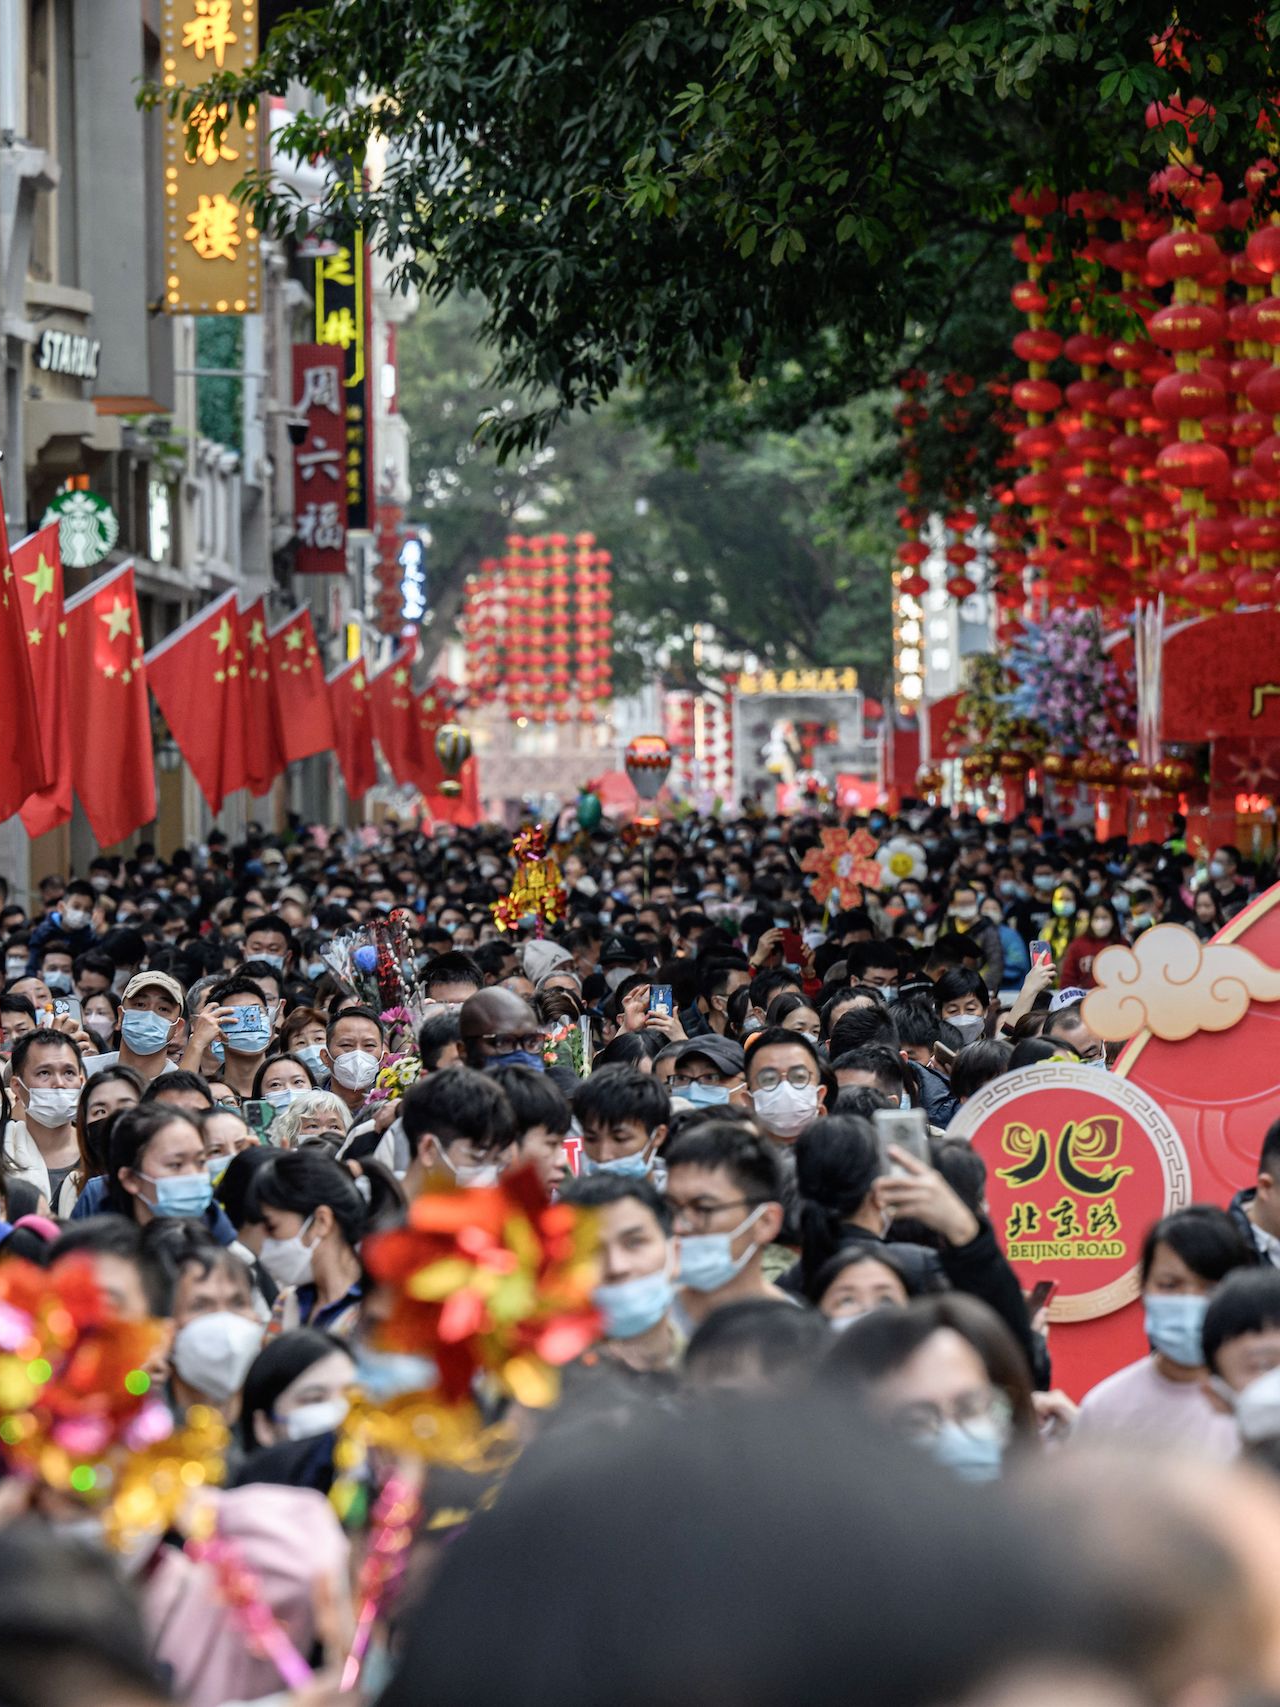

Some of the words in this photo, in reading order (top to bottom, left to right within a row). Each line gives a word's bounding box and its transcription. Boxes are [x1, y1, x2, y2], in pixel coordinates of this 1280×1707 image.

[296, 366, 344, 549] 周六福
[1007, 1198, 1120, 1239] 北京路
[1009, 1243, 1071, 1260] BEIJING
[1077, 1242, 1122, 1258] ROAD
